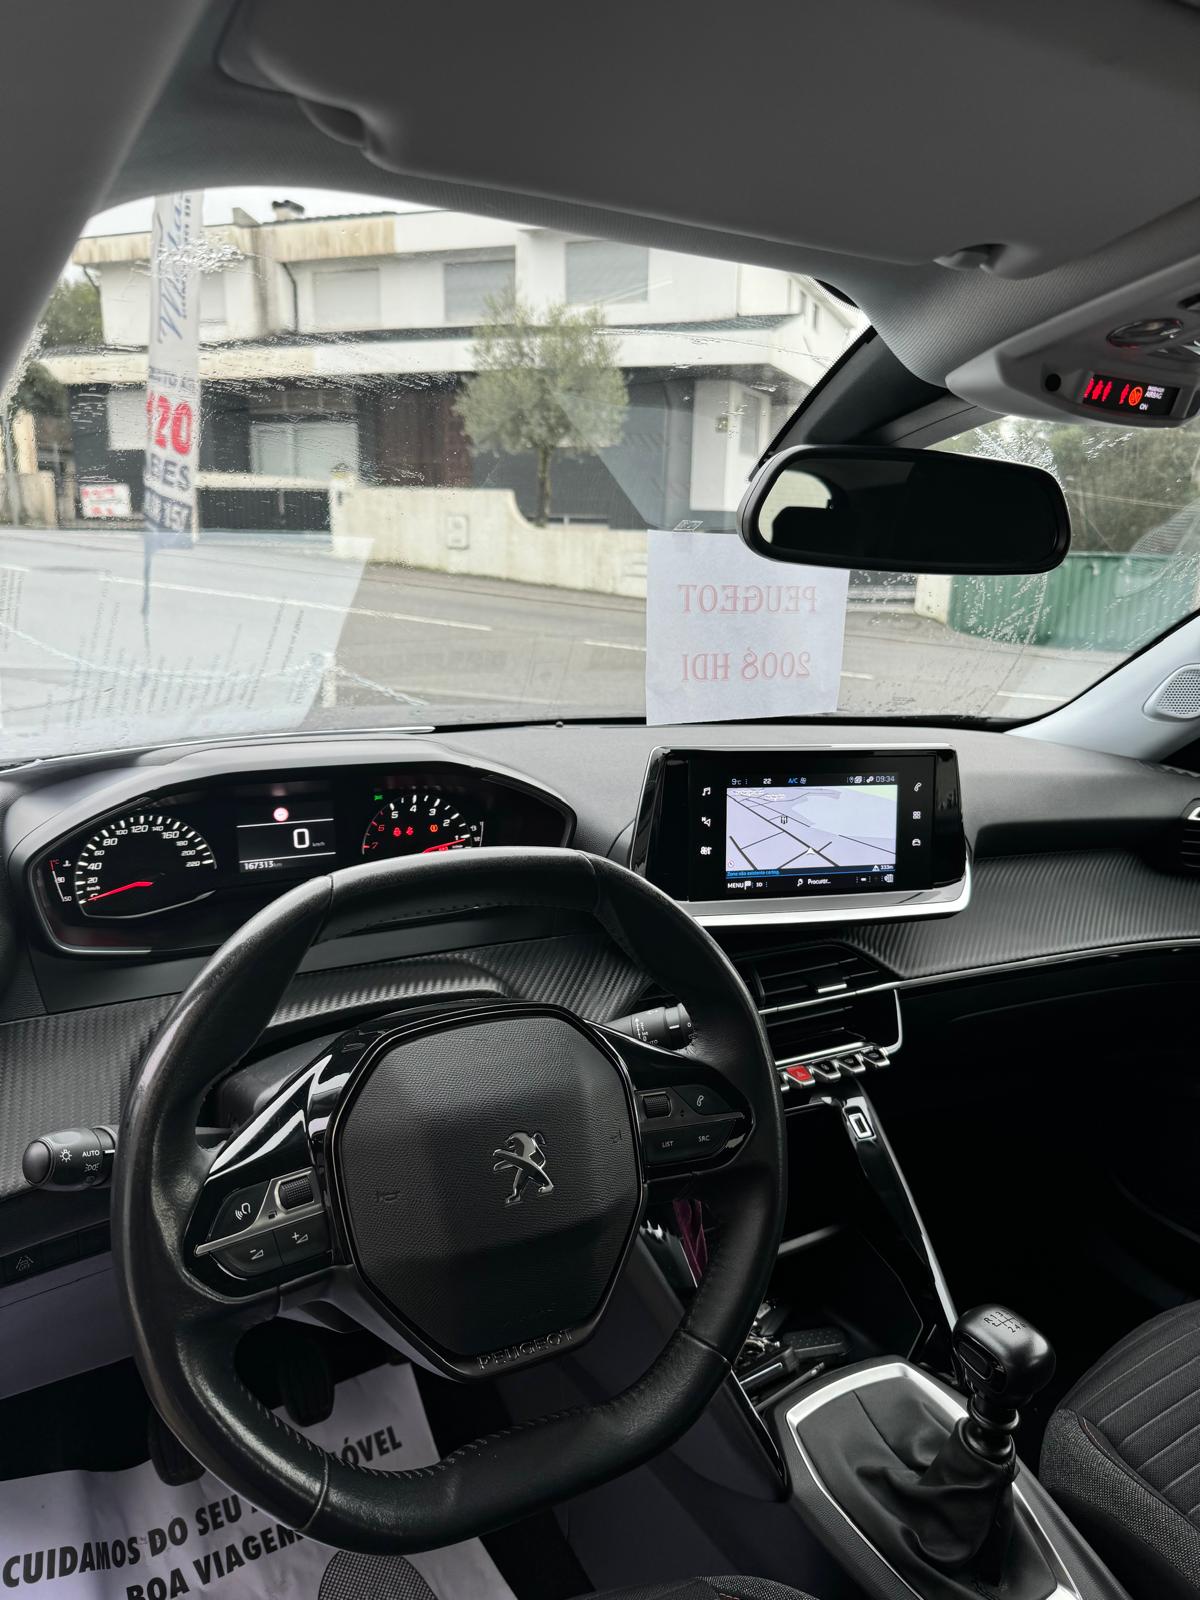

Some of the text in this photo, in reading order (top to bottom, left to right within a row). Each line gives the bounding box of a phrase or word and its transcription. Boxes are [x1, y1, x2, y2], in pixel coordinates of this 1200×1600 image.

[875, 775, 896, 783] 09:34
[409, 804, 417, 812] 4
[428, 808, 437, 816] 3
[391, 810, 399, 819] 5
[442, 819, 450, 827] 2
[130, 825, 149, 833] 120
[161, 831, 180, 839] 160
[293, 828, 310, 849] 0
[102, 838, 118, 847] 80
[181, 849, 196, 857] 200
[87, 862, 102, 870] 40
[243, 860, 274, 870] 167313
[661, 1140, 674, 1148] LIST
[82, 1149, 100, 1158] AUTO
[476, 1328, 574, 1370] PEUGEOT
[2, 1536, 141, 1588] CUIDAMOS
[147, 1517, 188, 1558] DO
[195, 1494, 242, 1536] SEU
[126, 1567, 190, 1600] BOA
